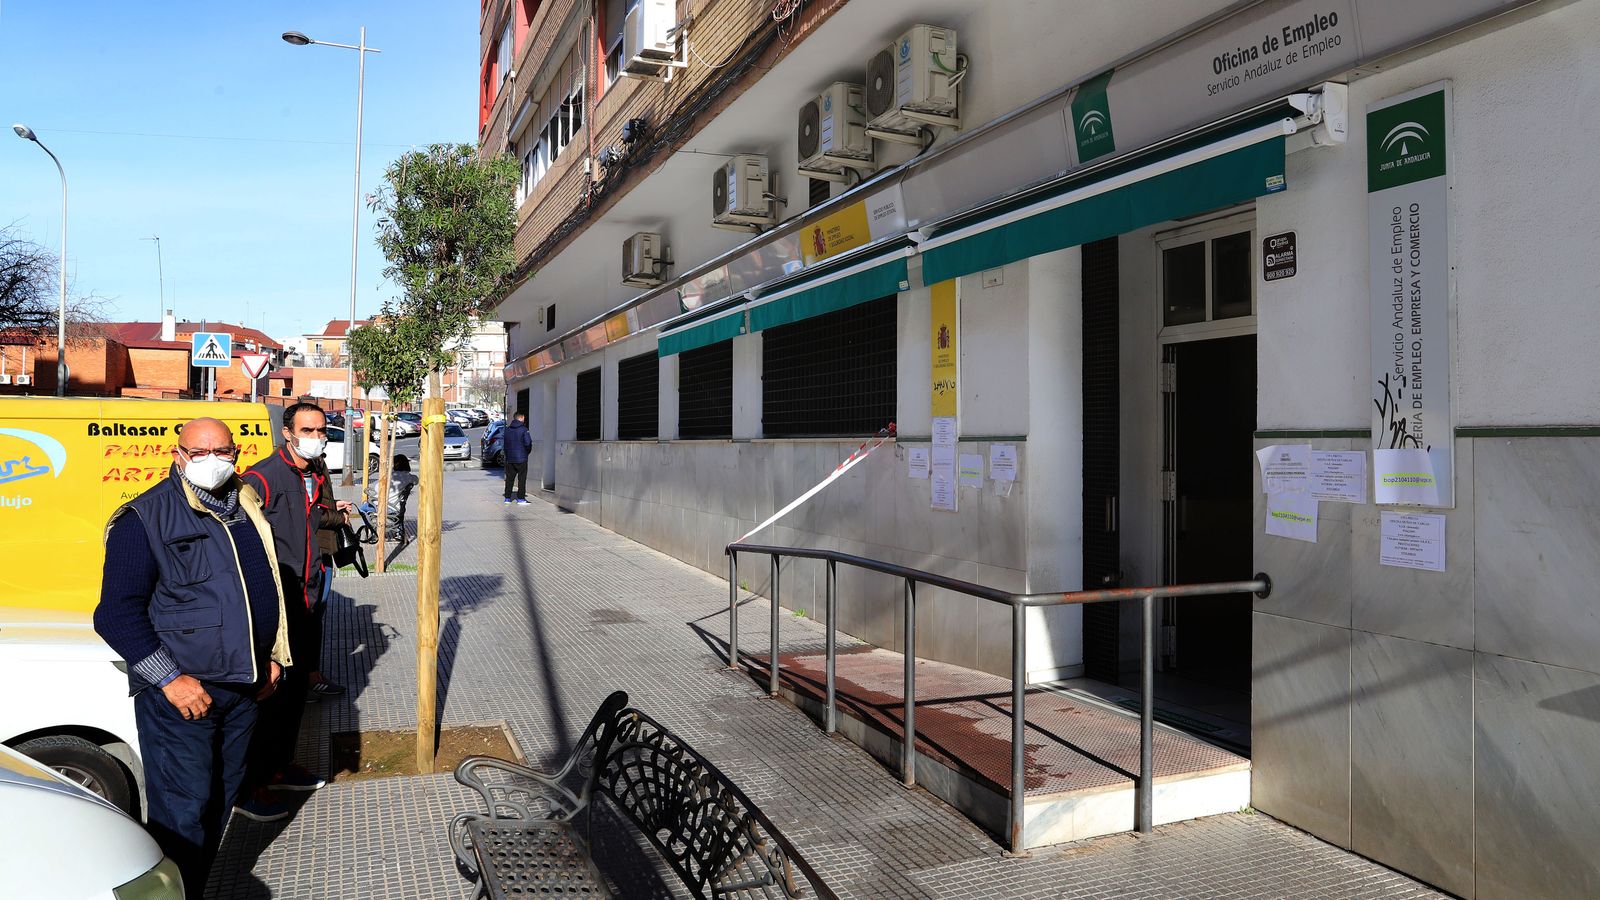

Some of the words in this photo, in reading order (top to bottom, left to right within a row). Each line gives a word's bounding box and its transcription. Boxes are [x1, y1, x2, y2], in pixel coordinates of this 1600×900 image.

[1207, 75, 1240, 97] Servicio
[1243, 58, 1283, 83] Andaluz
[1285, 52, 1298, 66] de
[1302, 34, 1342, 59] Empleo
[1212, 44, 1259, 75] Oficina
[1262, 35, 1279, 55] de
[1282, 11, 1339, 46] Empleo
[1379, 161, 1395, 171] JUNTA
[1396, 159, 1403, 167] DE
[1390, 206, 1405, 254] Empleo
[1409, 202, 1420, 267] COMERCIO
[1391, 258, 1403, 274] de
[1410, 270, 1421, 278] Y
[1392, 278, 1403, 329] Andaluz
[1411, 280, 1421, 334] EMPRESA
[1392, 332, 1404, 381] Servicio
[1411, 338, 1423, 390] EMPLEO,
[1412, 393, 1423, 409] DE
[87, 422, 168, 437] Baltasar
[240, 423, 268, 436] S.L.
